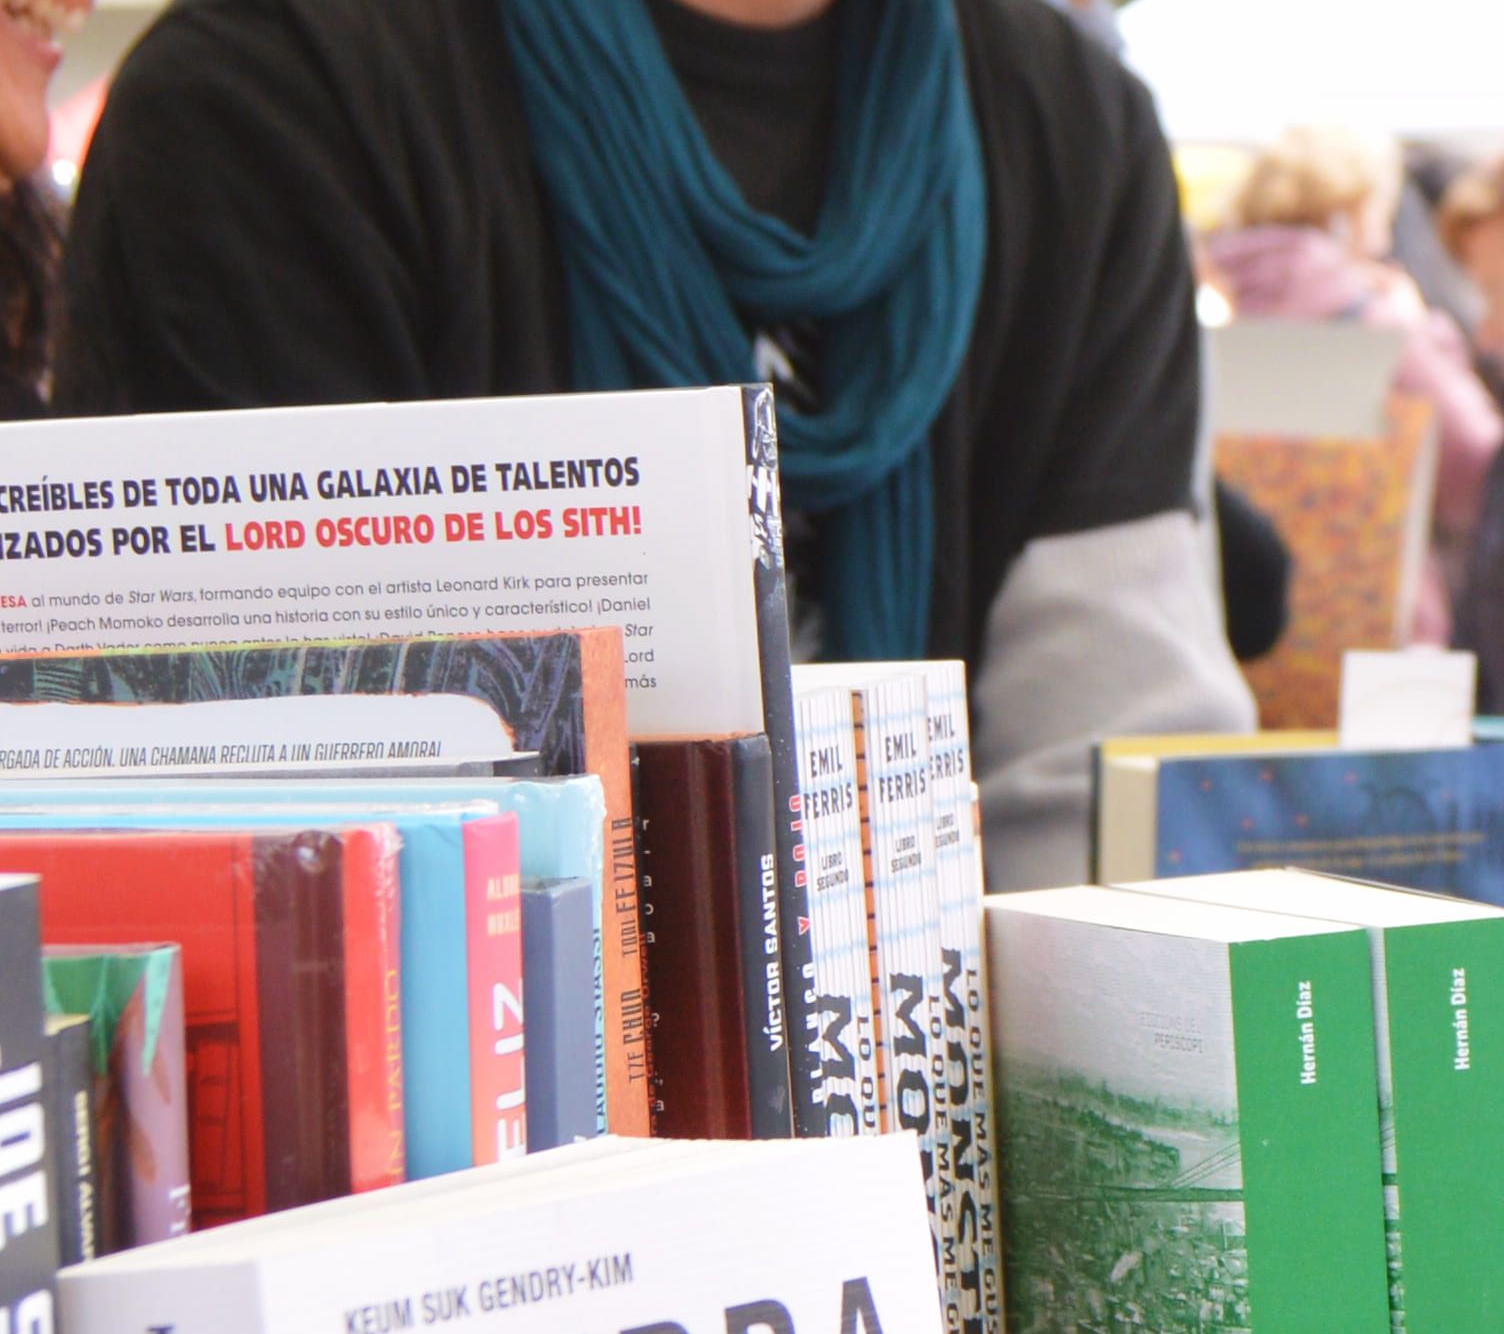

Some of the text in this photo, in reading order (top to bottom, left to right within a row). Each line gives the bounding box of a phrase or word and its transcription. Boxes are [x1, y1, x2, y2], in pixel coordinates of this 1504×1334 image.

[123, 479, 156, 507] DE
[165, 475, 241, 505] TODA
[250, 472, 309, 503] UNA
[317, 466, 443, 499] GALAXIA
[451, 464, 488, 493] DE
[496, 456, 640, 491] TALENTOS
[112, 525, 170, 556] POR
[180, 524, 216, 553] EL
[225, 520, 306, 552] LORD
[315, 513, 434, 548] OSCURO
[444, 512, 485, 543] DE
[494, 509, 553, 541] LOS
[562, 505, 642, 538] SITH!
[31, 590, 45, 609] al
[49, 588, 101, 607] mundo
[104, 587, 124, 606] de
[128, 587, 155, 605] Star
[160, 588, 198, 607] Wars,
[199, 584, 274, 603] formando
[278, 582, 331, 600] equipo
[335, 584, 365, 597] con
[368, 580, 382, 596] el
[386, 579, 432, 595] artista
[436, 576, 498, 593] Leonard
[503, 574, 530, 591] Kirk
[535, 577, 572, 592] para
[576, 572, 648, 591] presentar
[43, 749, 60, 768] DE
[63, 745, 114, 768] ACCIÓN.
[120, 746, 146, 766] UNA
[151, 745, 216, 765] CHAMANA
[221, 744, 274, 763] RECLUTA
[278, 743, 288, 762] A
[810, 745, 842, 778] EMIL
[886, 732, 917, 763] EMIL
[804, 782, 853, 820] FERRIS
[879, 768, 926, 803] FERRIS
[822, 852, 842, 870] LIBRO
[891, 851, 922, 873] SEGUNDO
[896, 835, 915, 853] LIBRO
[817, 869, 849, 891] SEGUNDO
[760, 854, 784, 1052] VÍCTOR SANTOS
[967, 968, 980, 1011] LO
[1297, 980, 1317, 1085] Hernán Díaz
[1451, 968, 1470, 1071] Hernán Díaz
[969, 1025, 987, 1102] QUE
[975, 1112, 991, 1191] MÁS
[980, 1203, 995, 1256] ME
[422, 1284, 471, 1324] SUK
[478, 1253, 634, 1312] GENDRY-KIM
